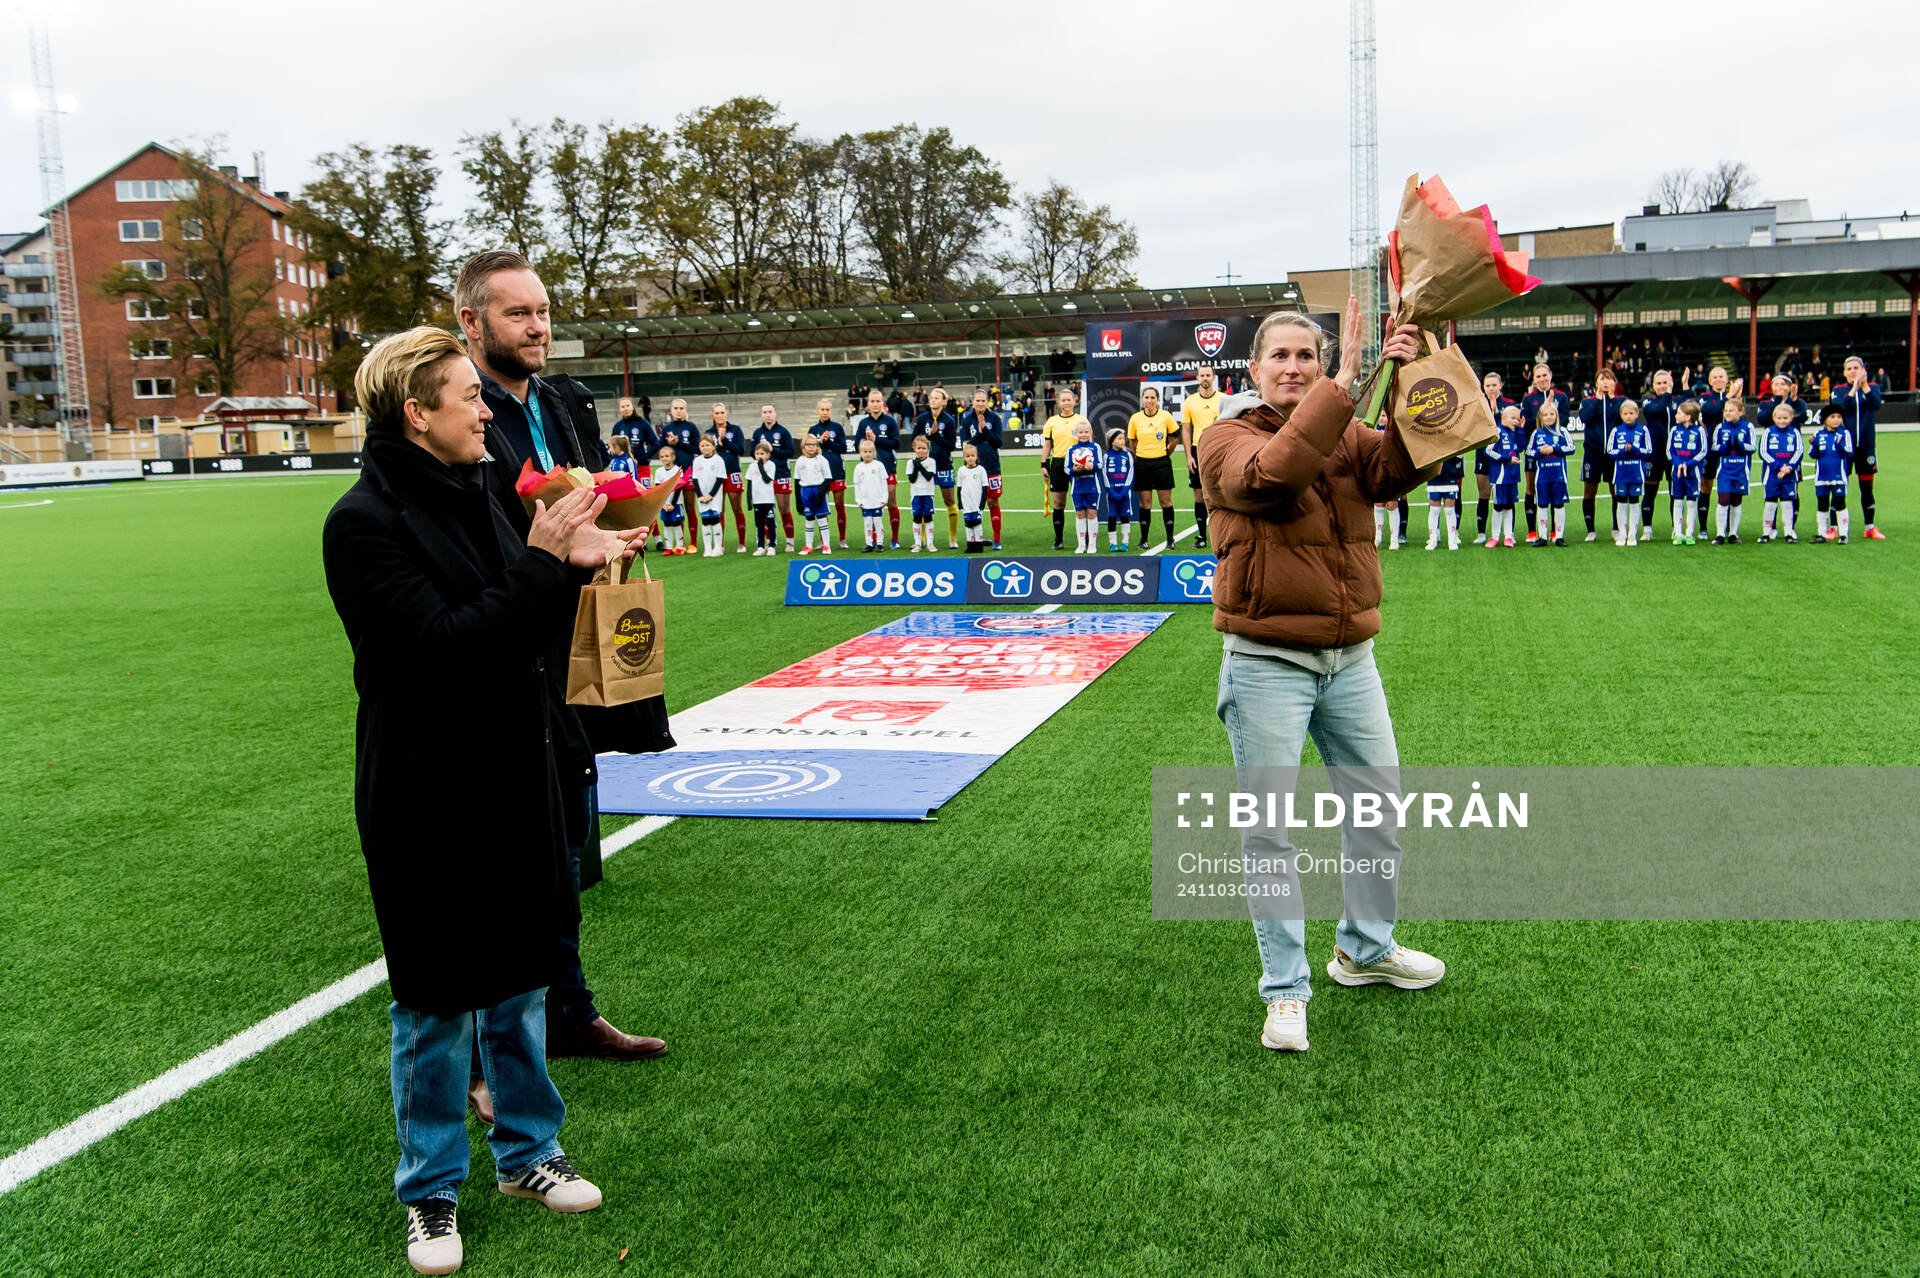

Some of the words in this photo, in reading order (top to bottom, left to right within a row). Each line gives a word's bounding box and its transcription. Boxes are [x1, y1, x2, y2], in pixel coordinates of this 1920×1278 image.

[1199, 330, 1222, 341] FCR
[1141, 362, 1173, 372] OBOS
[1425, 393, 1448, 408] OST
[855, 572, 955, 598] OBOS
[1040, 568, 1145, 596] OBOS
[632, 632, 651, 644] OST
[693, 727, 870, 736] SVENSKA
[884, 729, 980, 738] SPEL
